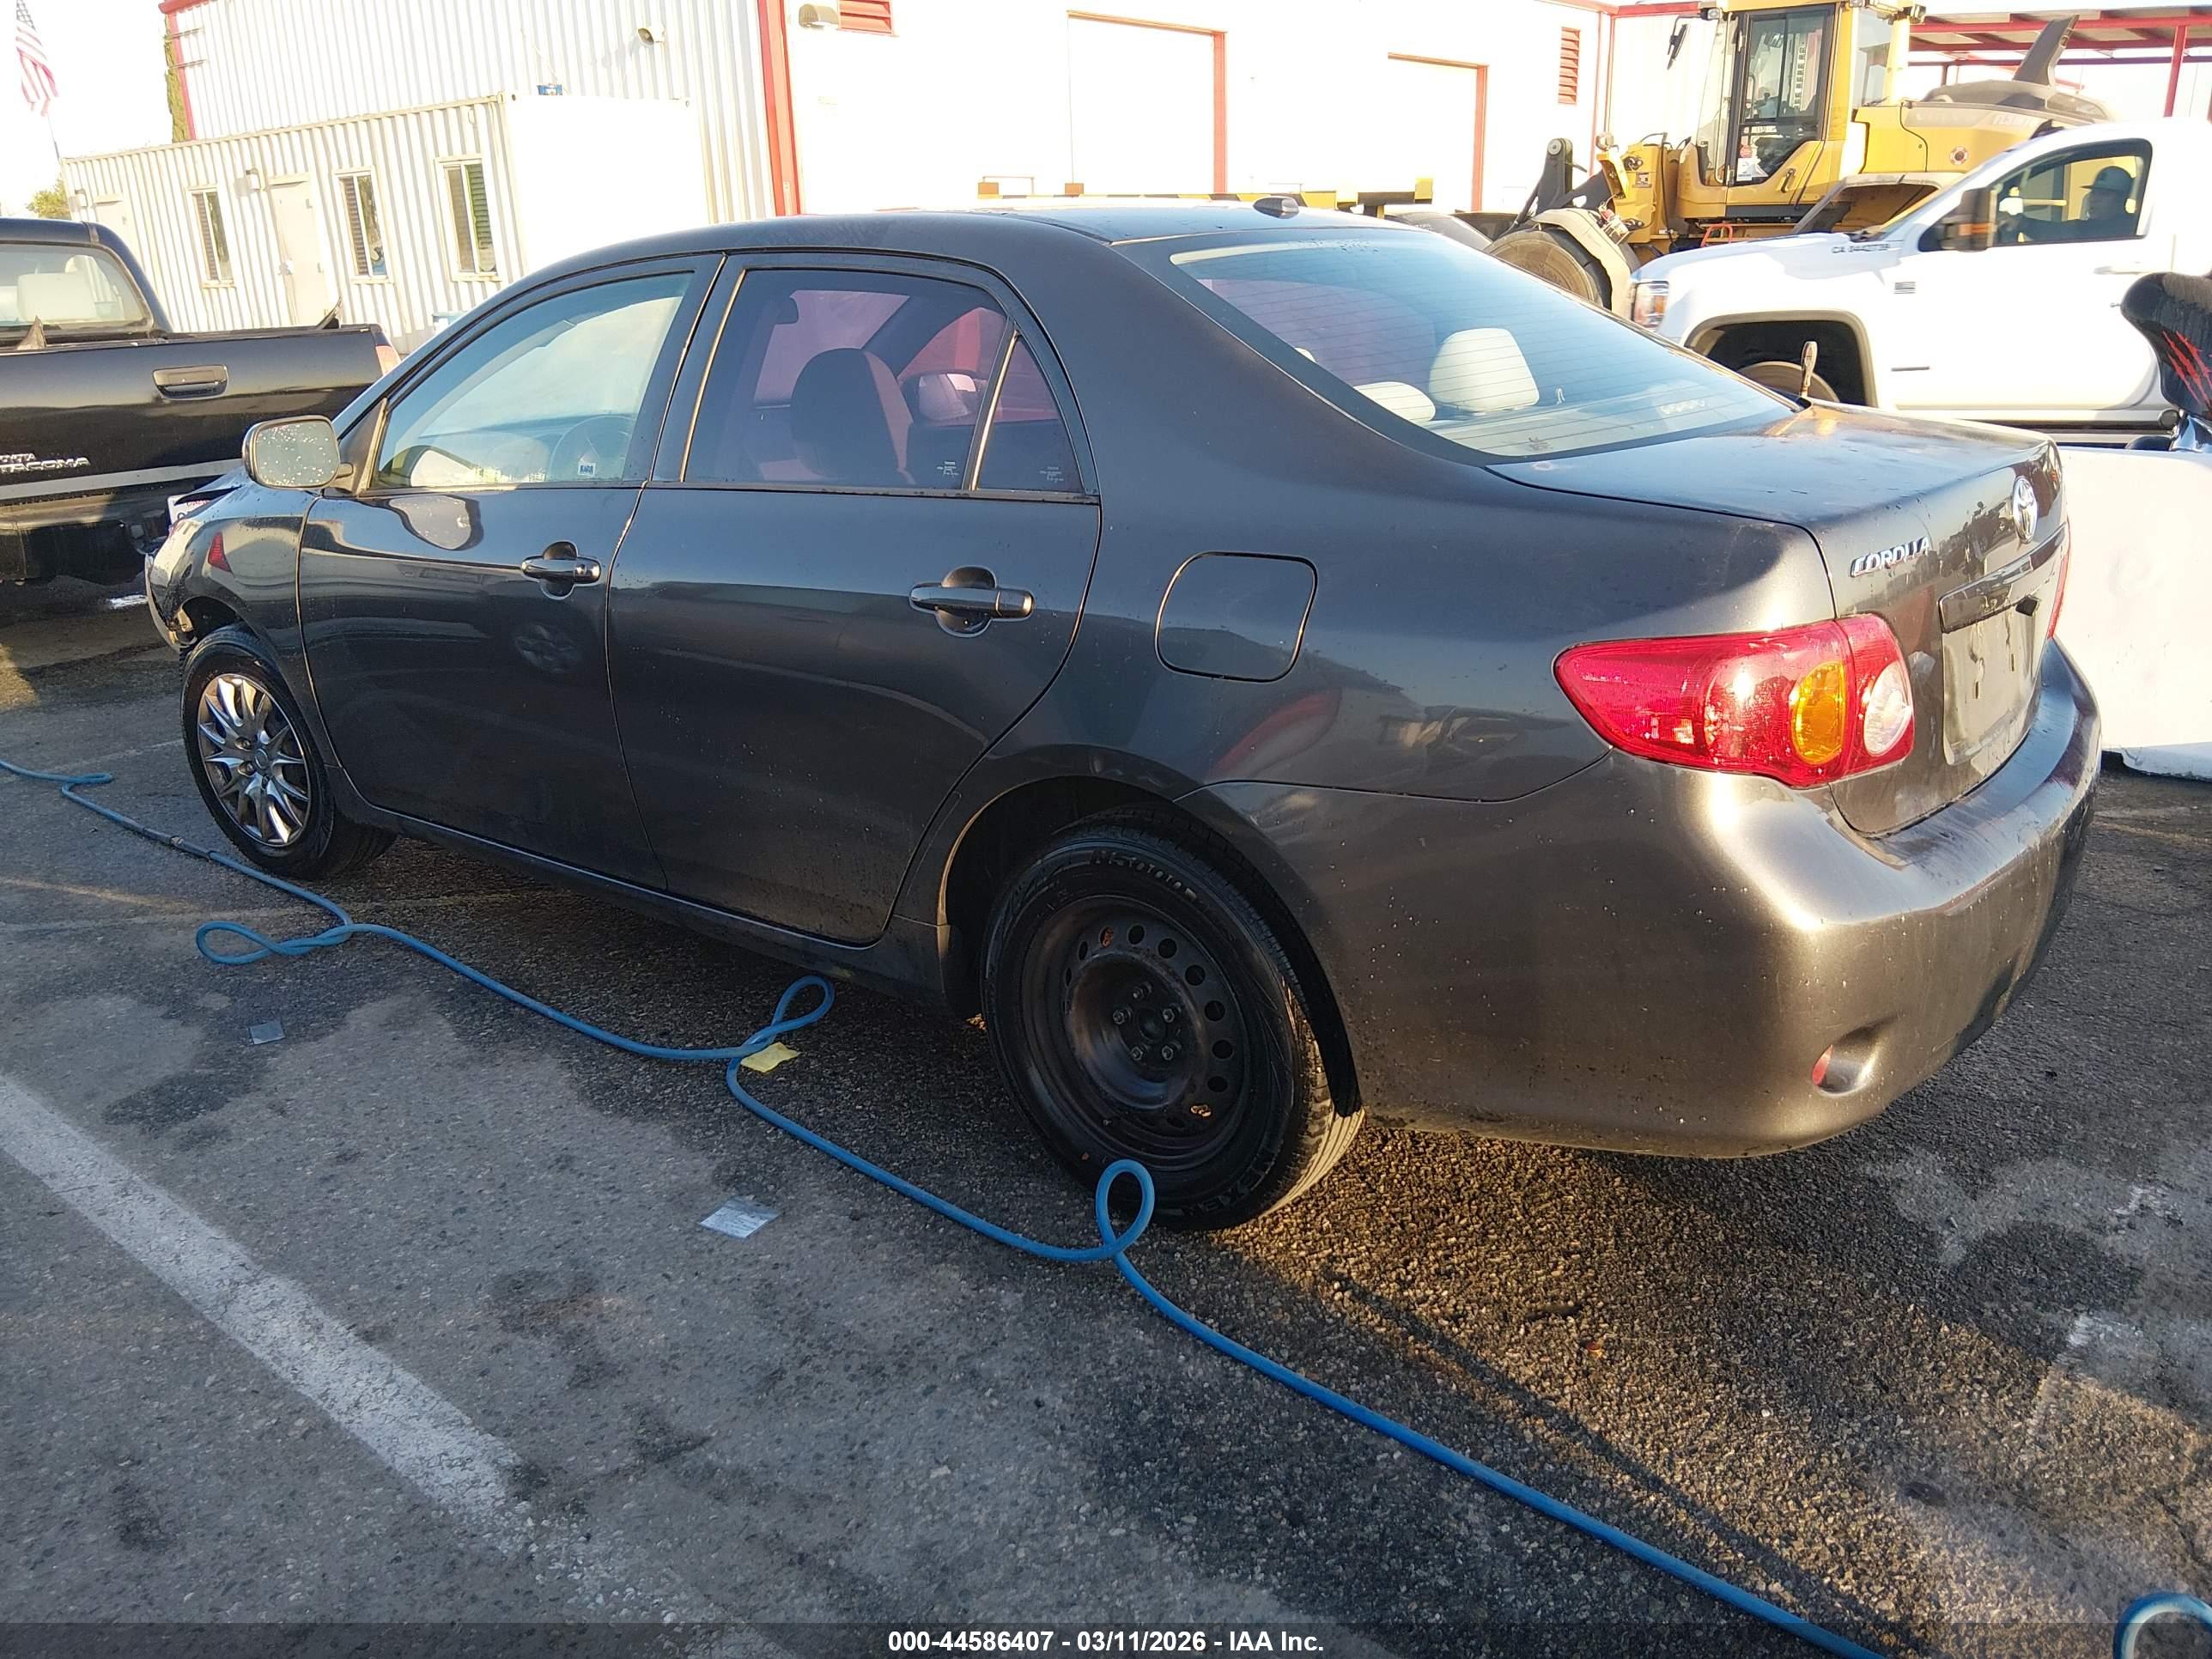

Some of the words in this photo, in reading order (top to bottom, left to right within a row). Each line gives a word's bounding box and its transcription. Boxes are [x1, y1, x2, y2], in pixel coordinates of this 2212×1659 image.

[0, 452, 36, 464] OYOTA
[0, 457, 91, 474] TACOMA
[1850, 535, 1930, 578] COROLLA
